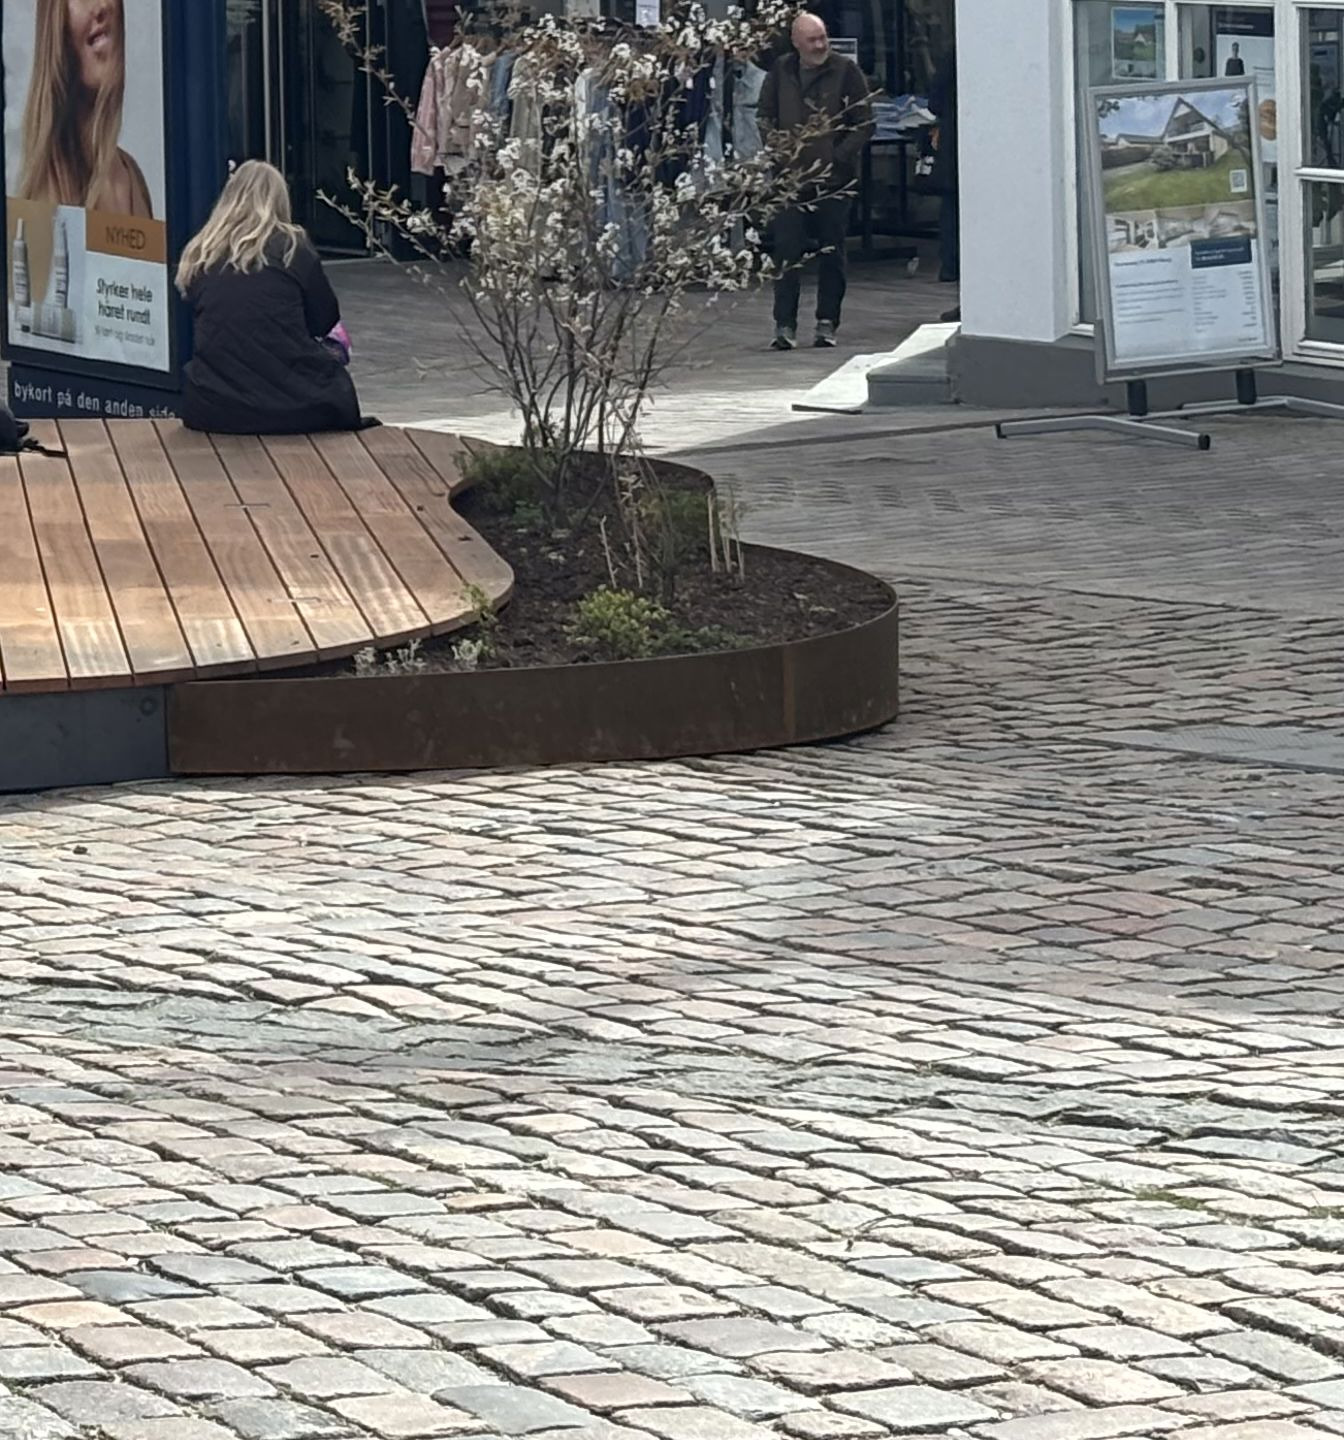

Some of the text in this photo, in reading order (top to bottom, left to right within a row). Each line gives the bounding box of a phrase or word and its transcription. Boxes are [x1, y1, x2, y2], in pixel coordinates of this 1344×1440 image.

[105, 226, 146, 250] NYHED
[14, 380, 52, 402] bykort
[57, 388, 72, 408] på
[77, 392, 100, 410] den
[105, 400, 144, 418] anden
